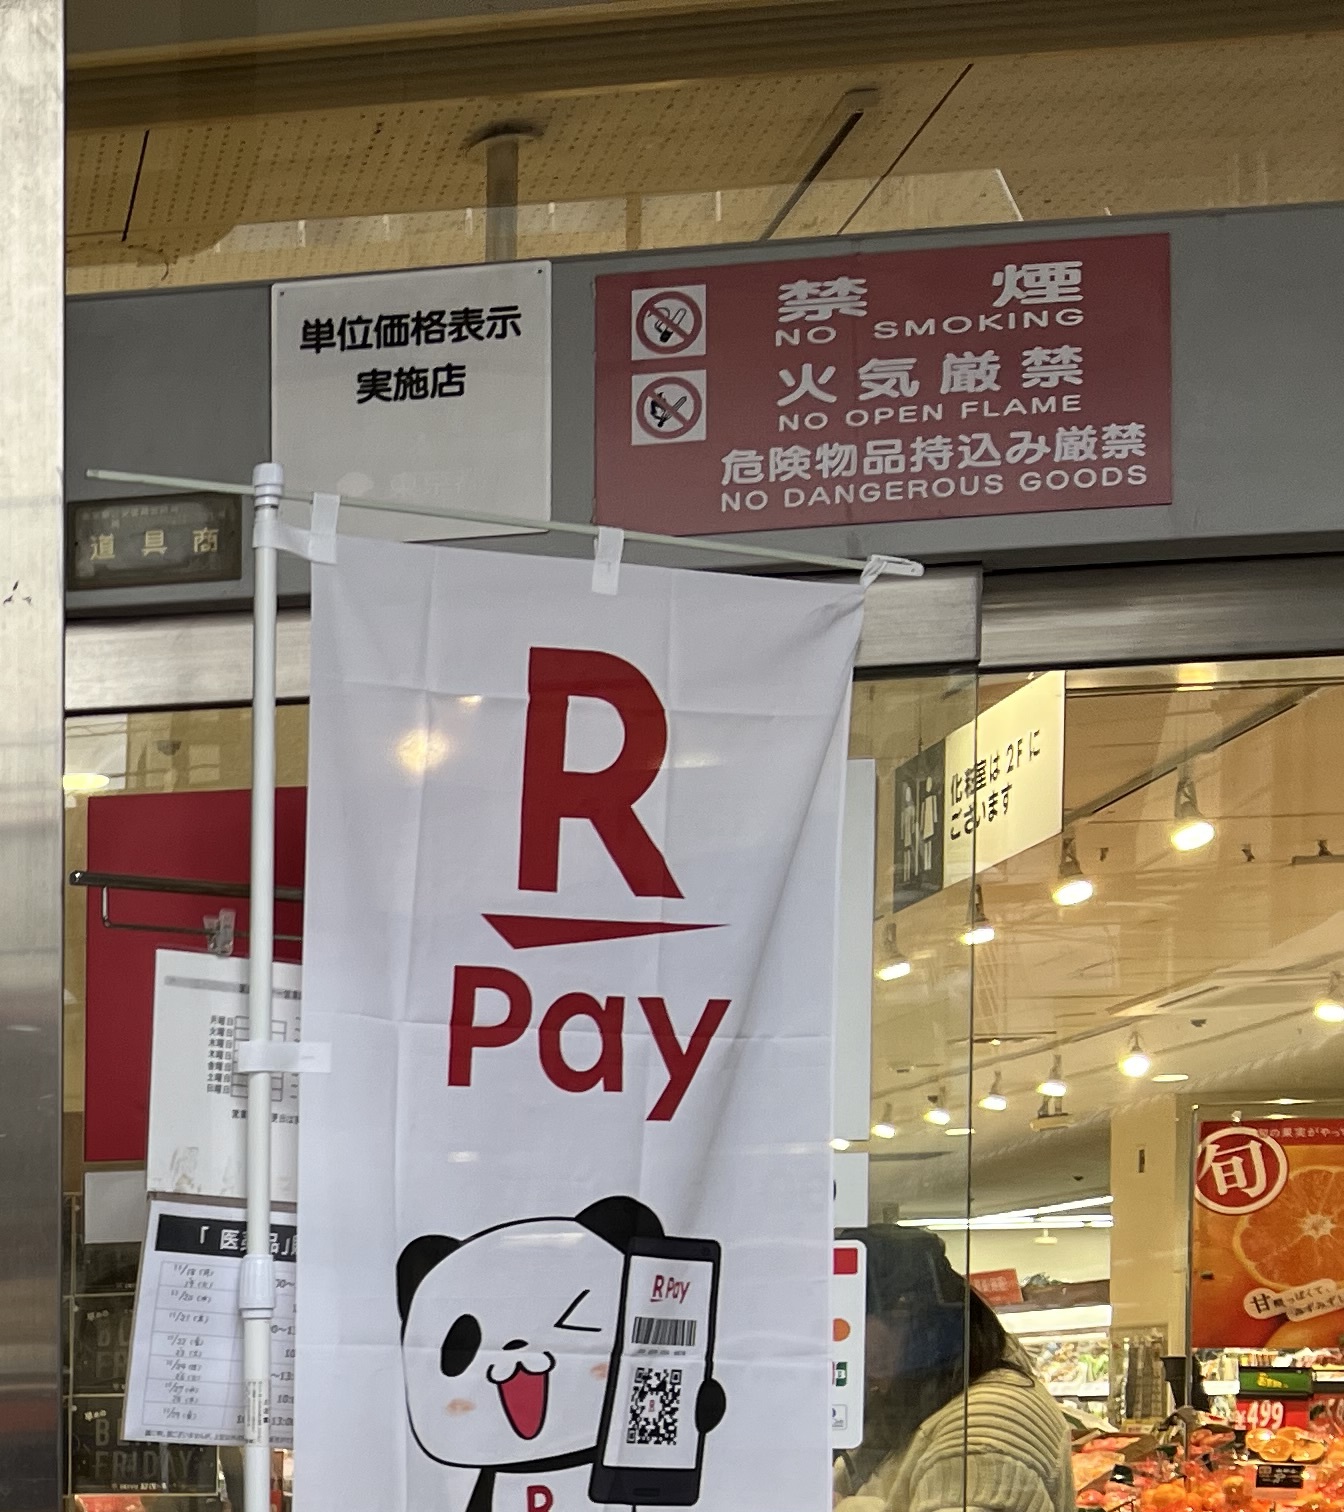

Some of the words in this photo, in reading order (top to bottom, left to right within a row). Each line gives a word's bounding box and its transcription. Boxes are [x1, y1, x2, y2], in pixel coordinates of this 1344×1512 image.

[299, 305, 523, 354] 単位価格表示
[775, 325, 838, 349] NO
[872, 307, 1085, 341] SMOKING
[355, 363, 467, 404] 実施店
[777, 343, 1084, 407] 火気厳禁
[778, 411, 830, 432] NO
[845, 402, 944, 428] OPEN
[960, 393, 1083, 421] FLAME
[720, 421, 1147, 487] 危険物品持込み厳禁
[721, 490, 770, 513] NO
[784, 473, 1005, 510] DANGEROUS
[1019, 463, 1149, 493] GOODS
[518, 646, 686, 900] R
[447, 964, 733, 1122] Pay
[1198, 1139, 1267, 1198] 旬
[665, 1275, 691, 1304] Pay
